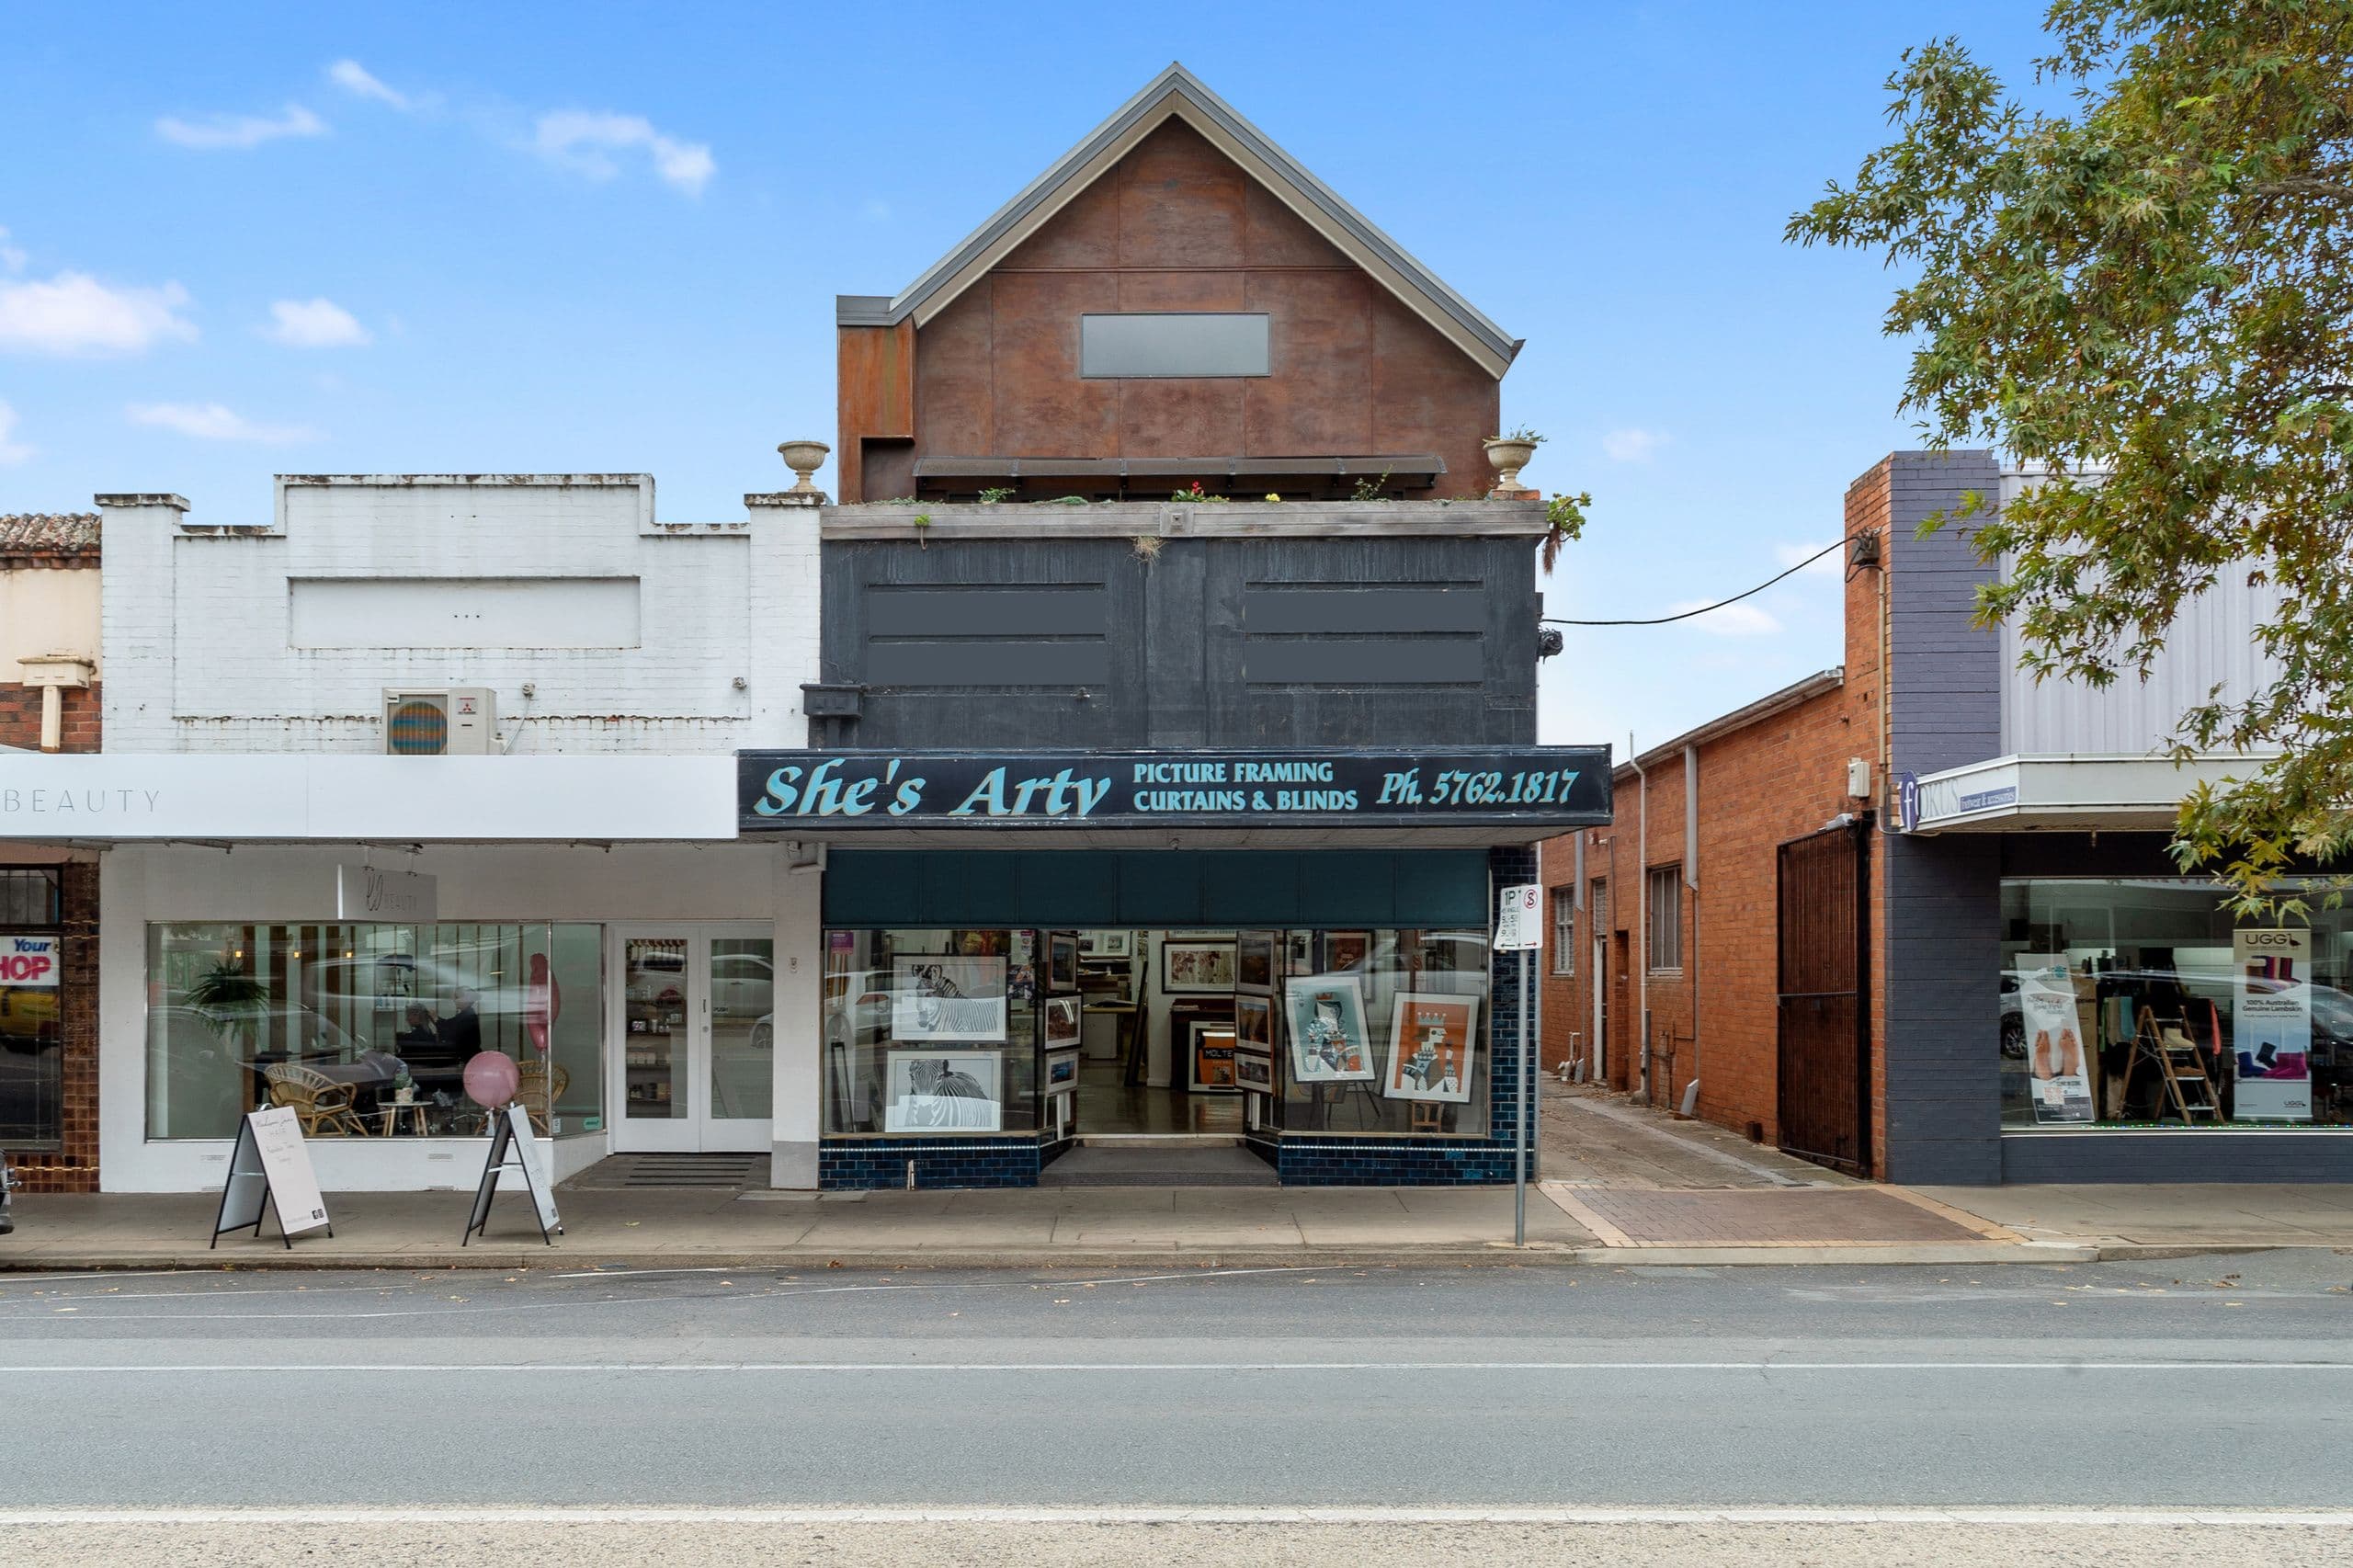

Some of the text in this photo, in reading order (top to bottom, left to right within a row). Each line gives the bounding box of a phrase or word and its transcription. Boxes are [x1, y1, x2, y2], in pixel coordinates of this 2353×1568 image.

[1133, 761, 1335, 784] PICTURE FRAMING
[754, 756, 1112, 817] She's Arty
[1375, 767, 1580, 805] Ph. 5762.1817
[4, 789, 160, 812] BEAUTY
[1133, 790, 1359, 811] CURTAINS & BLINDS
[14, 938, 51, 952] Your
[2245, 933, 2288, 945] UGG
